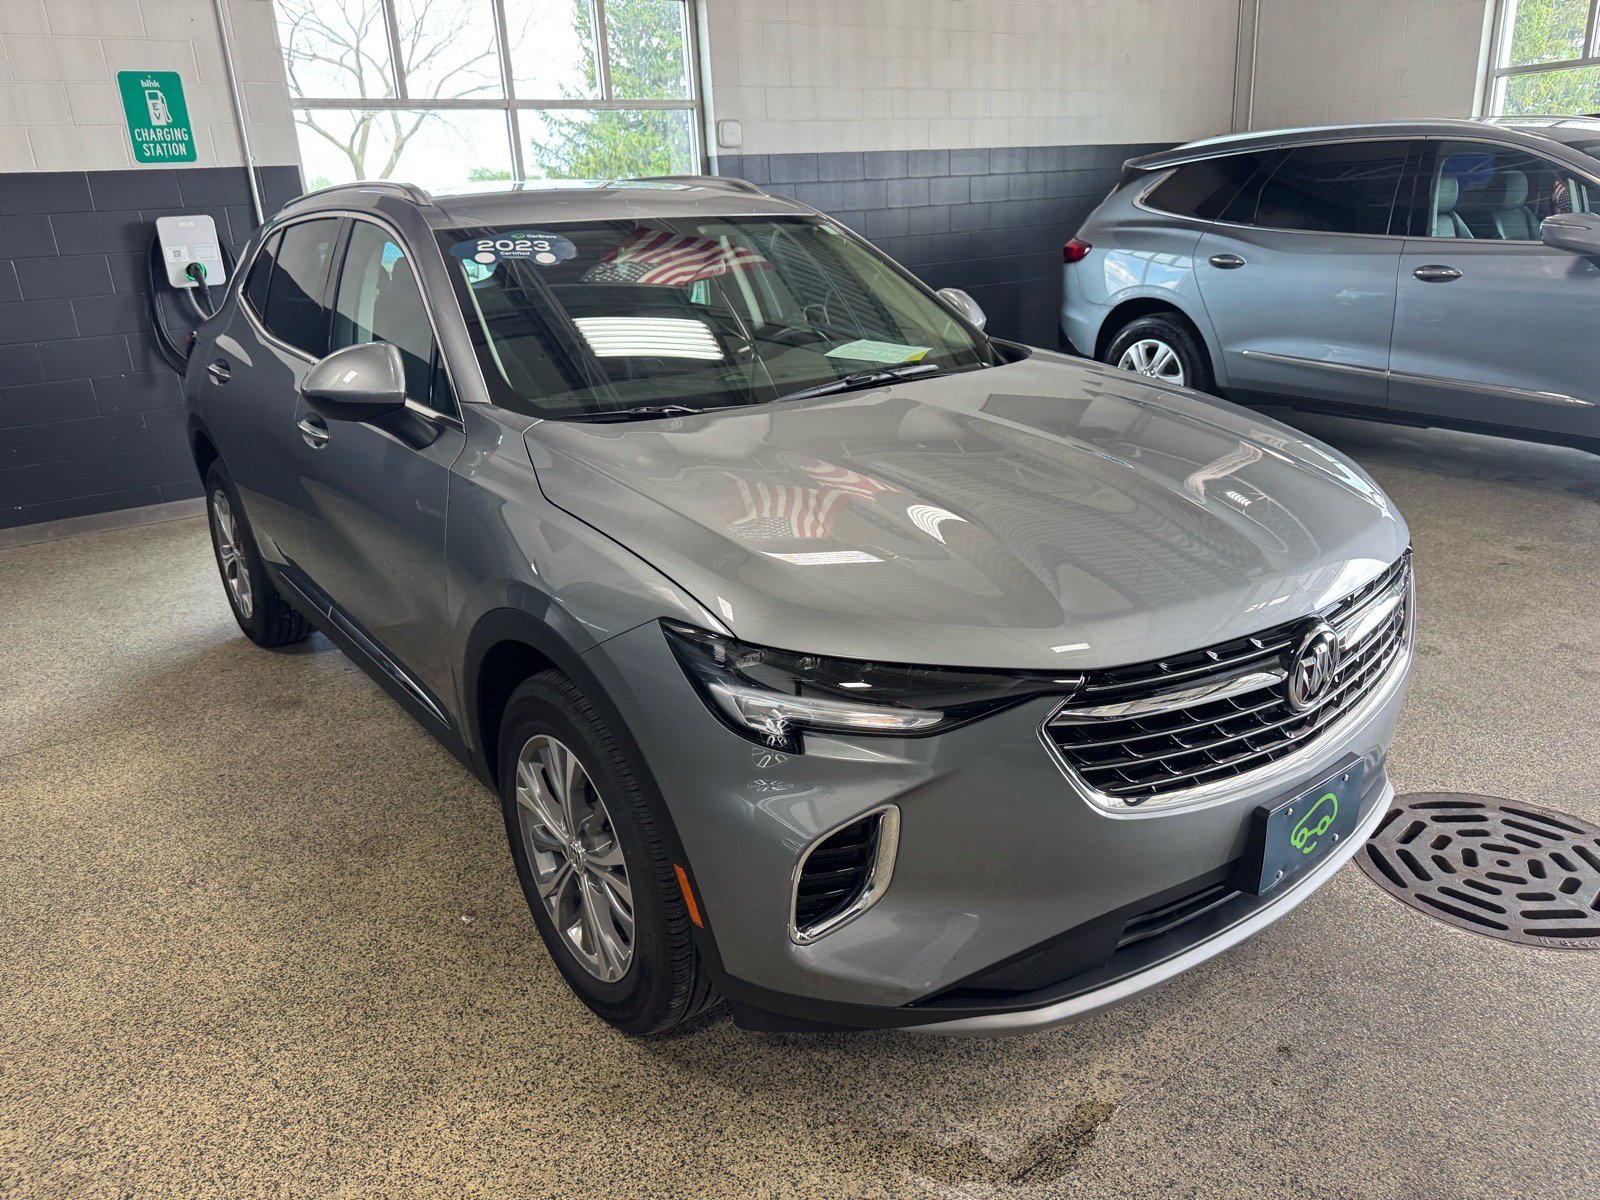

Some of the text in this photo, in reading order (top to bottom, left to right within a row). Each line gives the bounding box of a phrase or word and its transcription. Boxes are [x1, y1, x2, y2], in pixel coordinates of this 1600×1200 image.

[140, 80, 160, 88] blink
[134, 128, 188, 141] CHARGING
[143, 143, 187, 156] STATION
[477, 240, 551, 251] 2023
